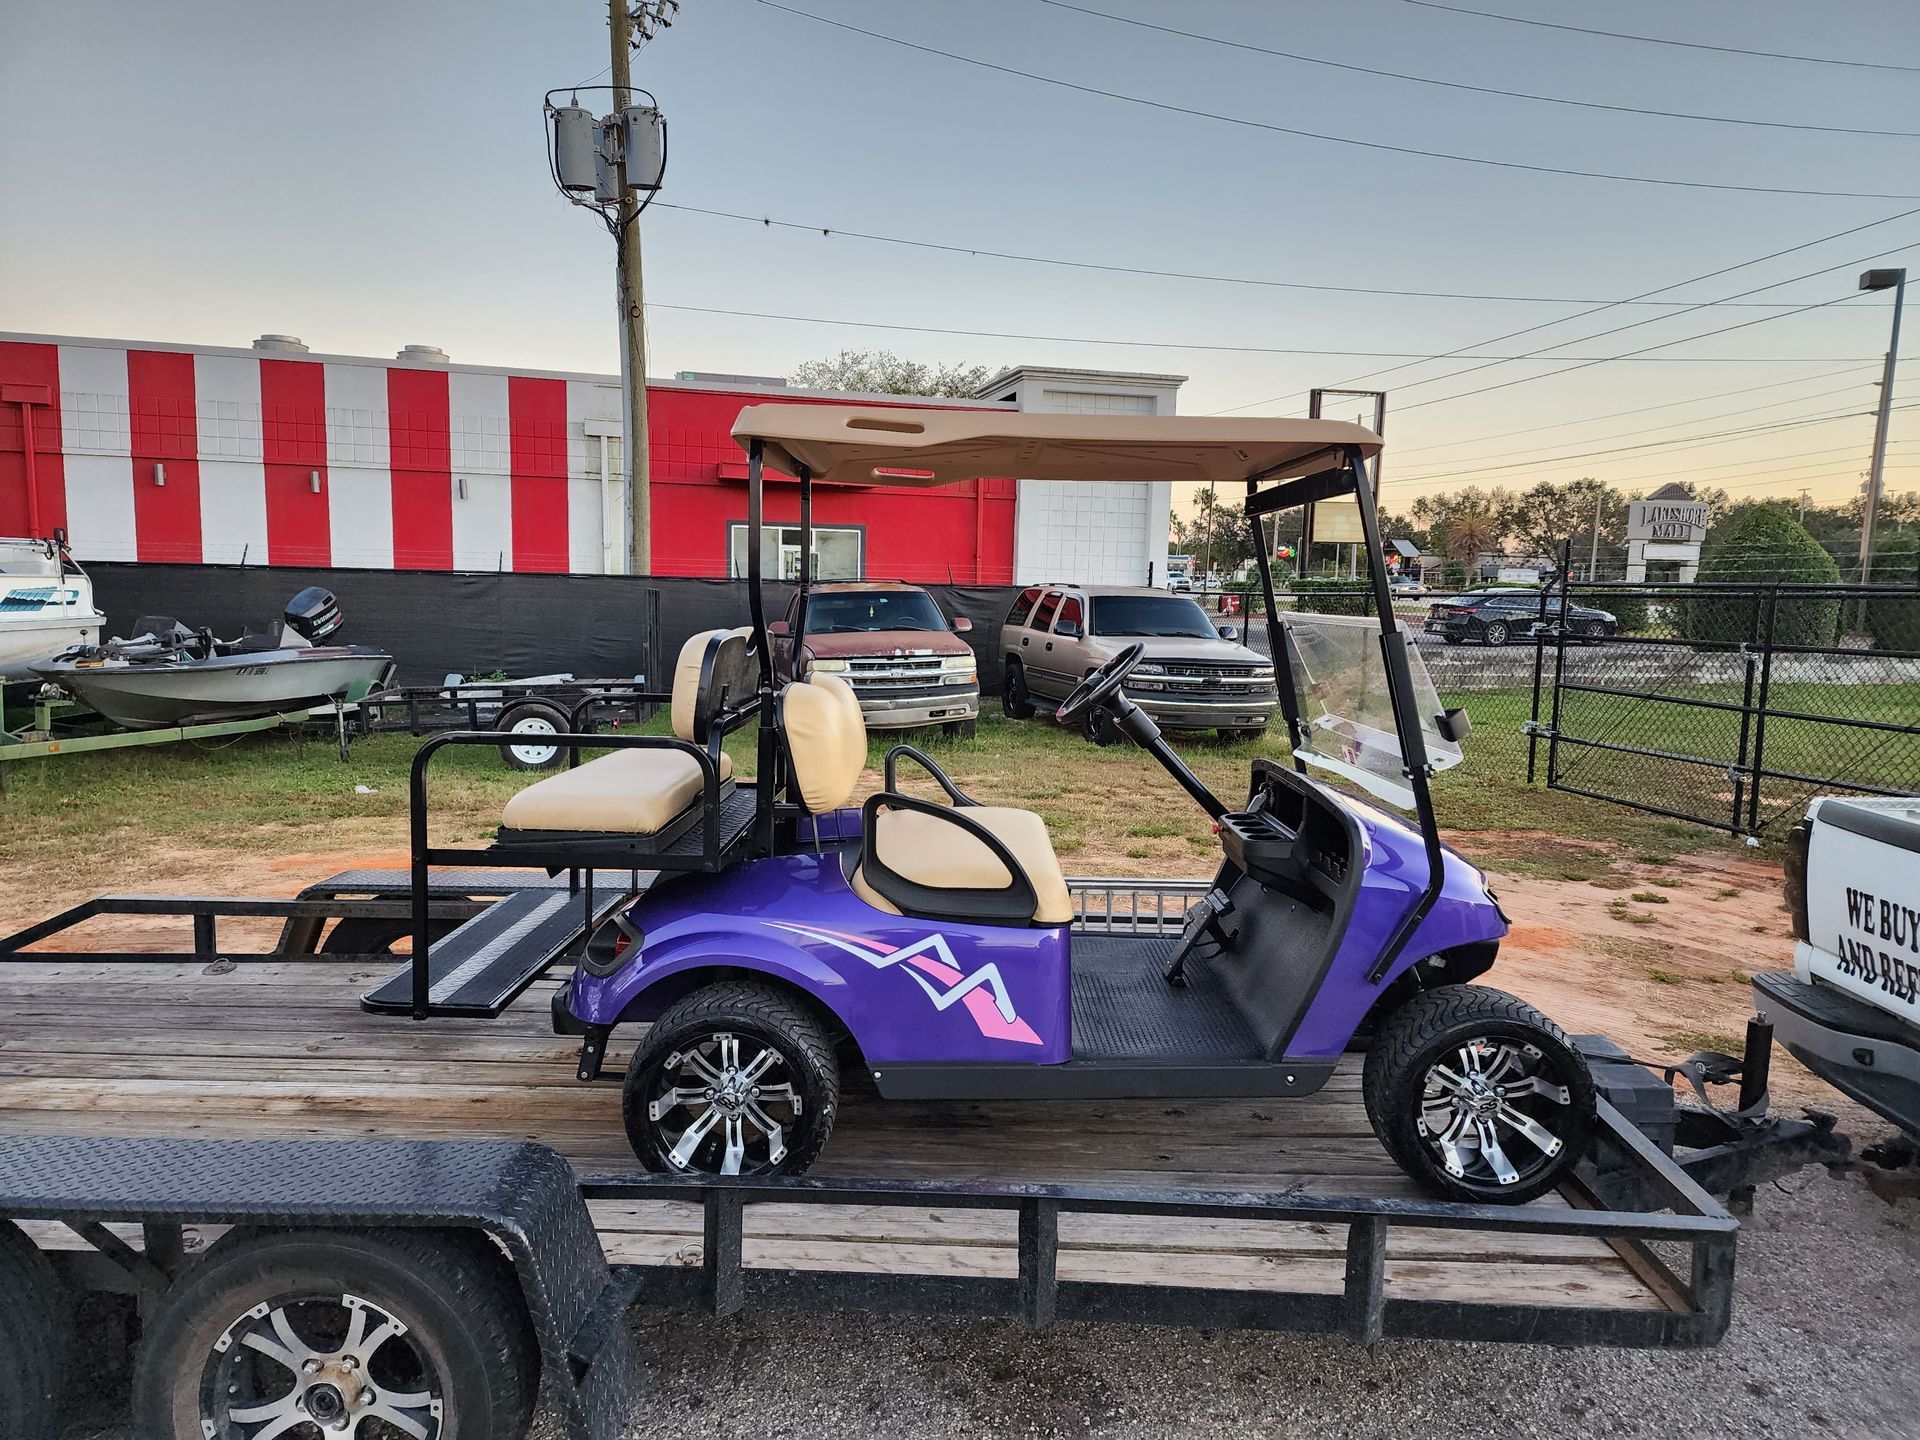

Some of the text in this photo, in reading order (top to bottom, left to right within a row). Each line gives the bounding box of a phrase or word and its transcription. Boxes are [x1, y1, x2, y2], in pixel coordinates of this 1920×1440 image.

[1640, 506, 1706, 527] LAKESHORE
[1652, 523, 1689, 537] MALL
[1846, 887, 1920, 953] WE BUY
[1837, 934, 1920, 1005] AND REF
